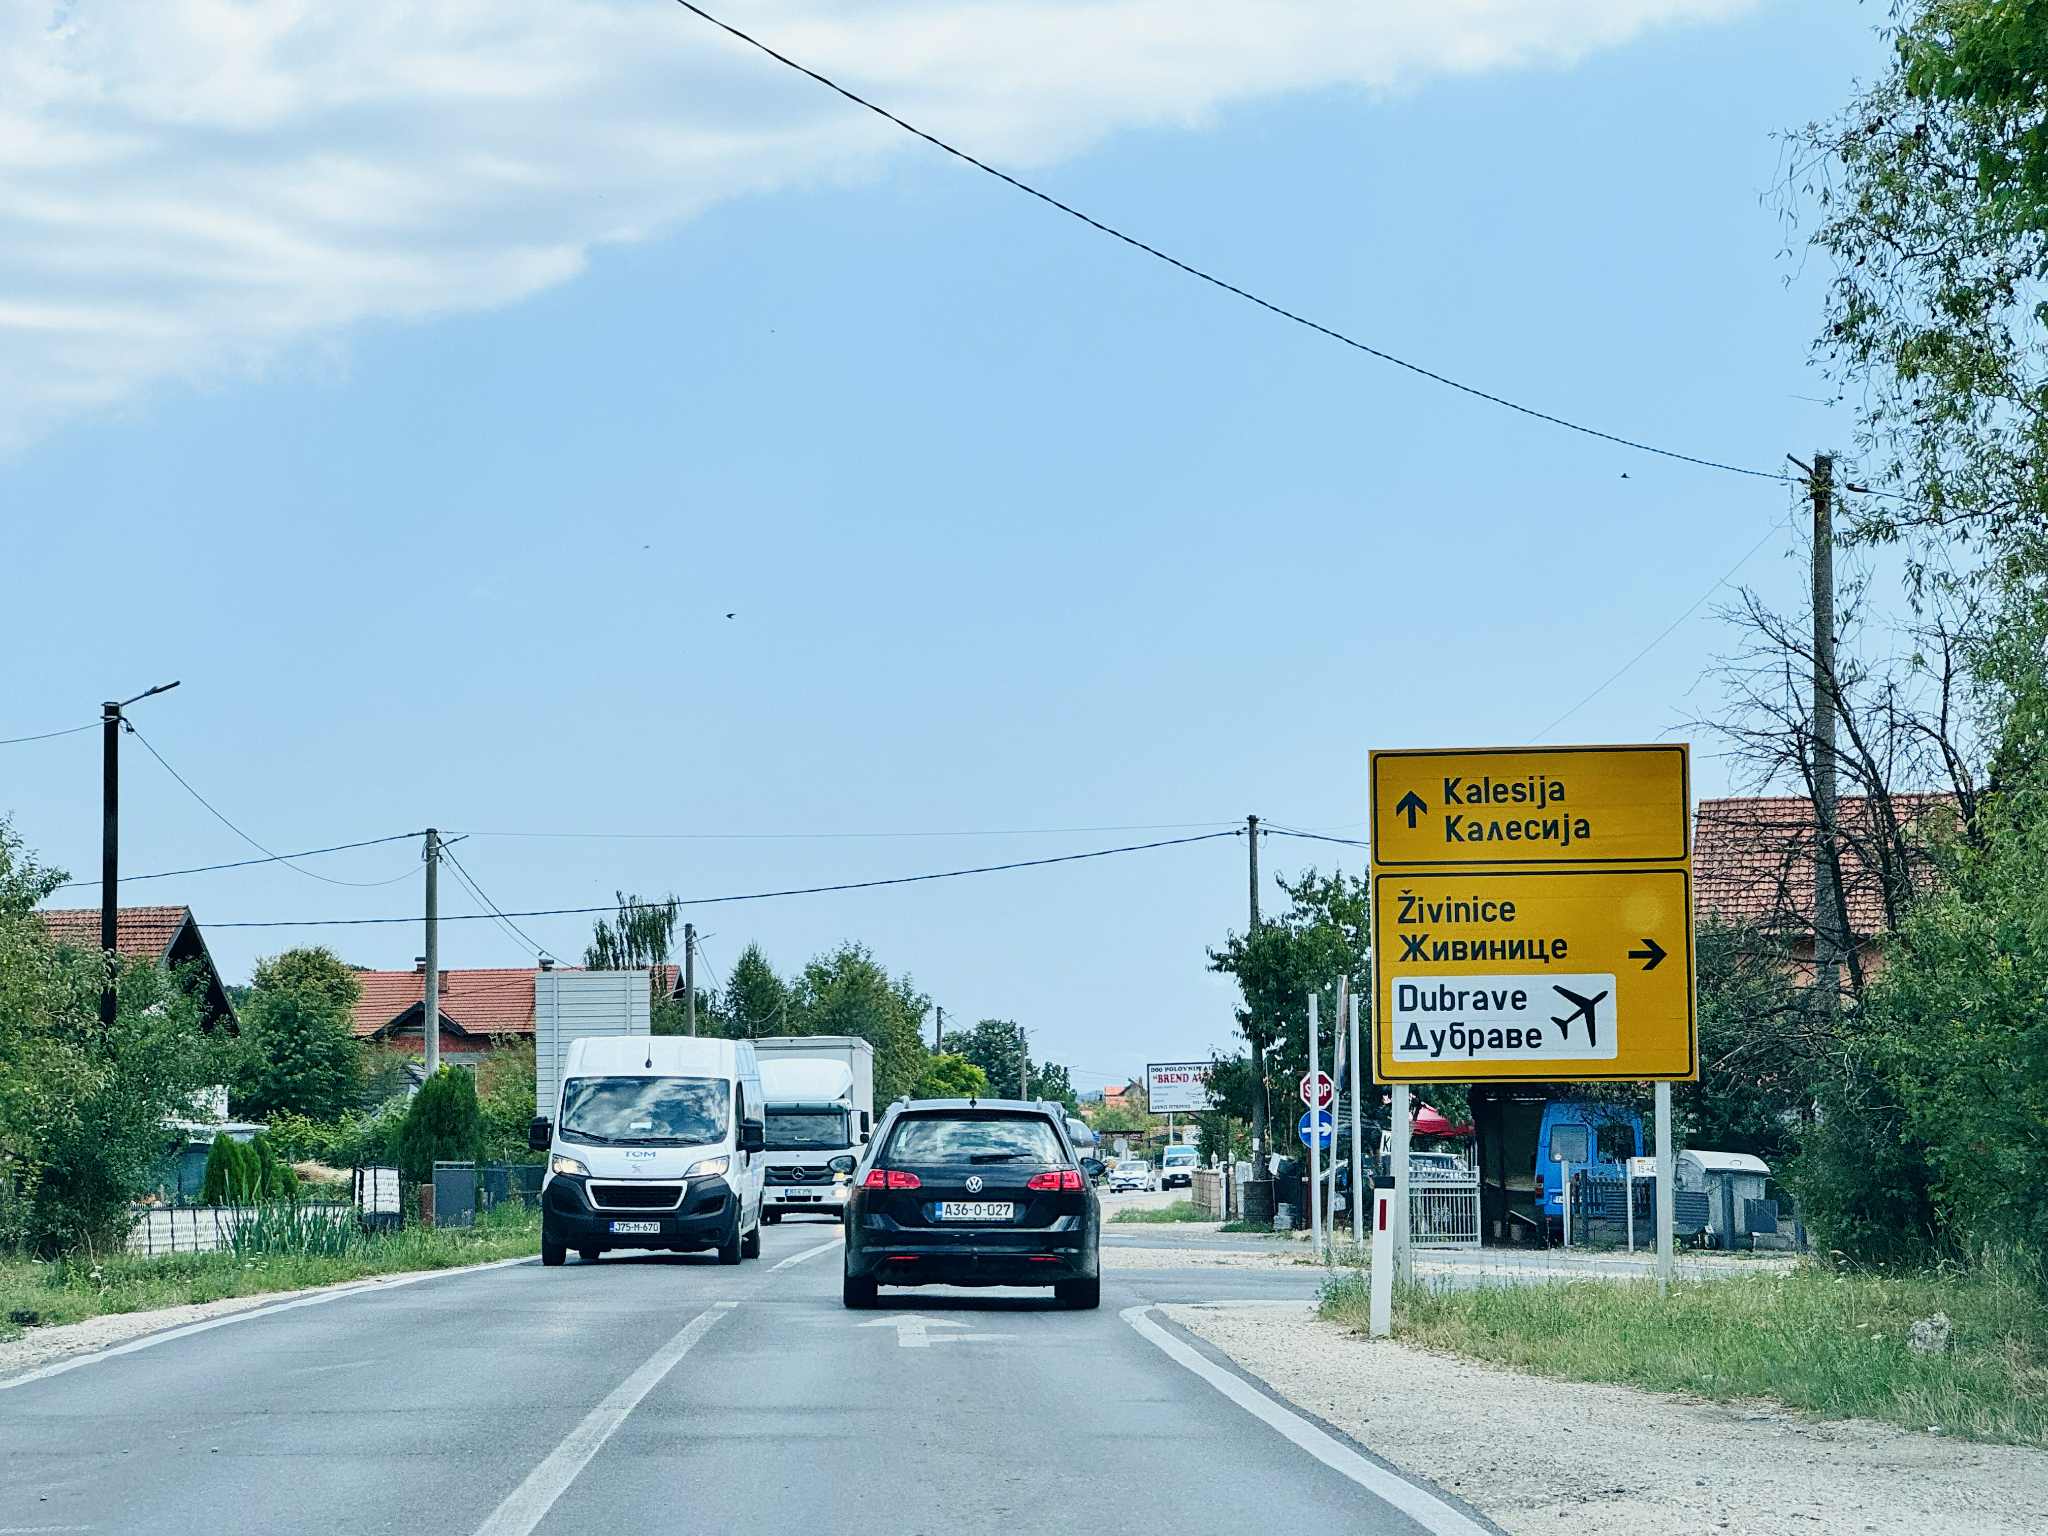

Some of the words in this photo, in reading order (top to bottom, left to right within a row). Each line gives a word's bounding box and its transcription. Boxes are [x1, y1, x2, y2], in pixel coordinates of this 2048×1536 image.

[1443, 776, 1565, 810] Kalesija
[1445, 813, 1591, 847] Калесија
[1397, 889, 1516, 924] Živinice
[1398, 934, 1568, 964] Живинице
[1399, 983, 1528, 1012] Dubrave
[1400, 1022, 1542, 1057] Дубраве
[1304, 1083, 1331, 1097] SOP
